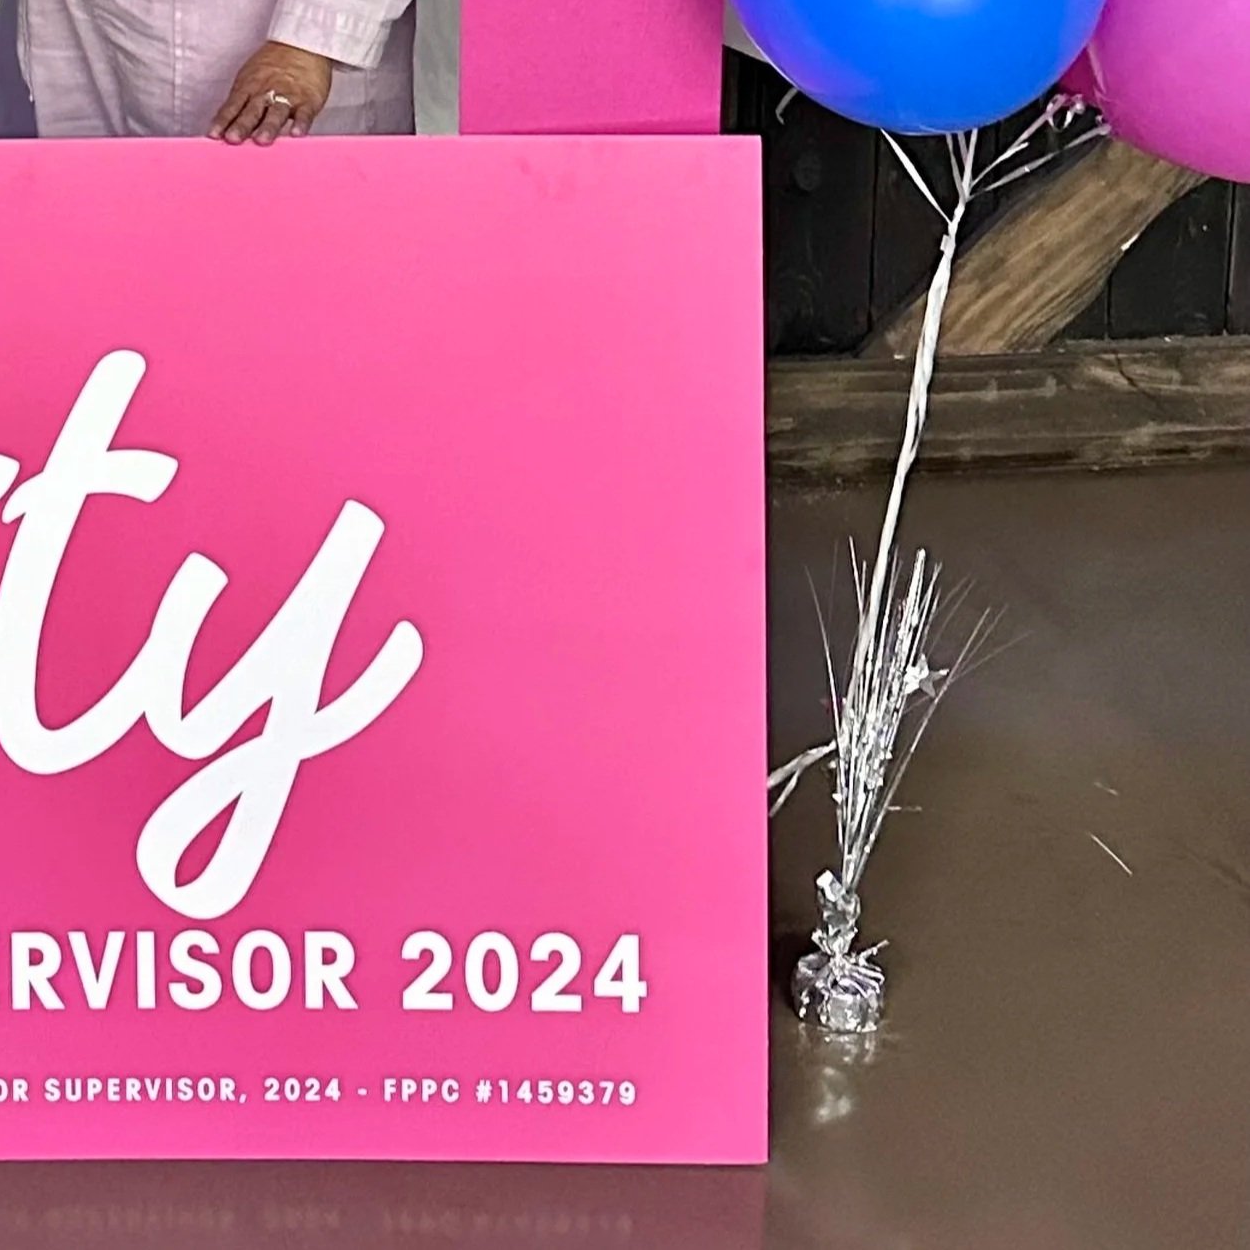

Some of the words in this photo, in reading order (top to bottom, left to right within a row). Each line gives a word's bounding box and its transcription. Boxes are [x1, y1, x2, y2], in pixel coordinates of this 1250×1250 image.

[400, 929, 648, 1013] 2024
[44, 1077, 248, 1104] SUPERVISOR,
[263, 1077, 342, 1102] 2024
[383, 1078, 460, 1103] FPPC
[474, 1079, 637, 1106] #1459379
